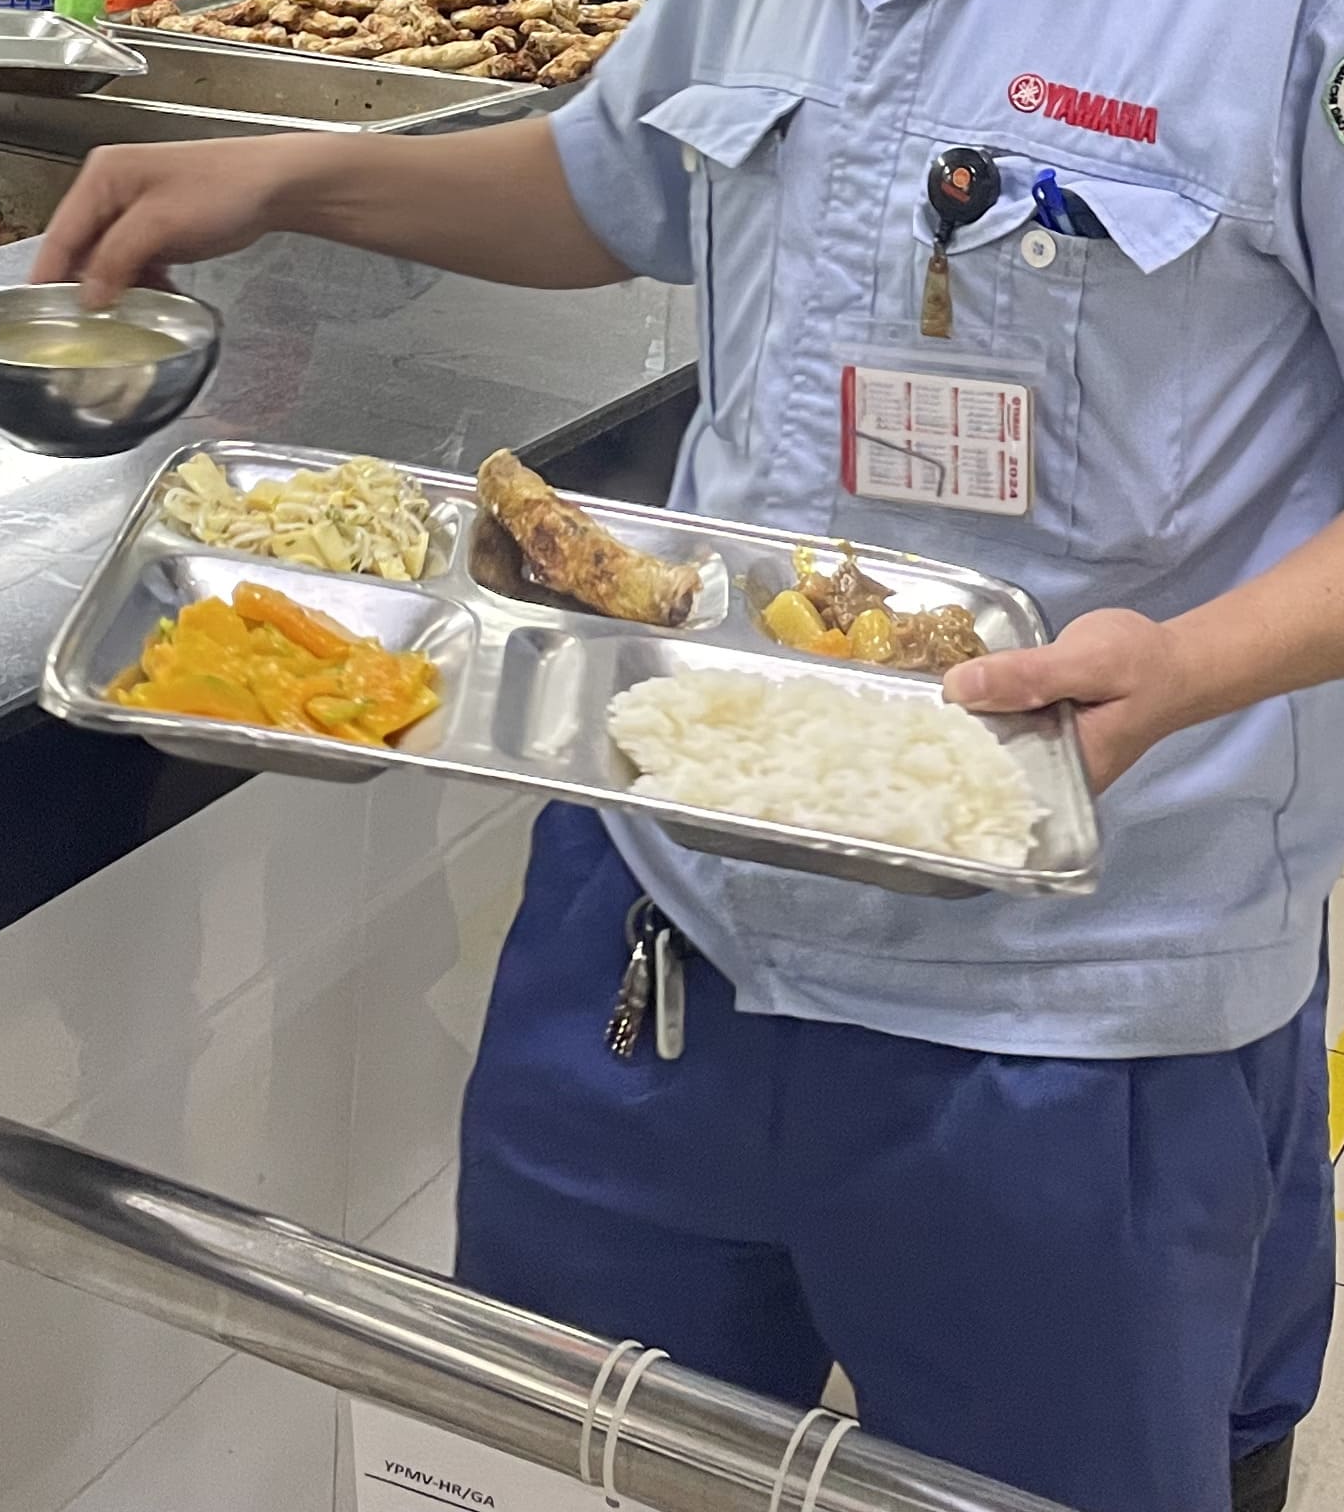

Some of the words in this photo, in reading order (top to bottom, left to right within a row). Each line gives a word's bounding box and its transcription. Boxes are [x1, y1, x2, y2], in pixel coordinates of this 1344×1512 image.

[1043, 82, 1158, 145] YAMAHA
[1008, 455, 1019, 499] 2024
[384, 1459, 495, 1509] YPMV-HR/GA
